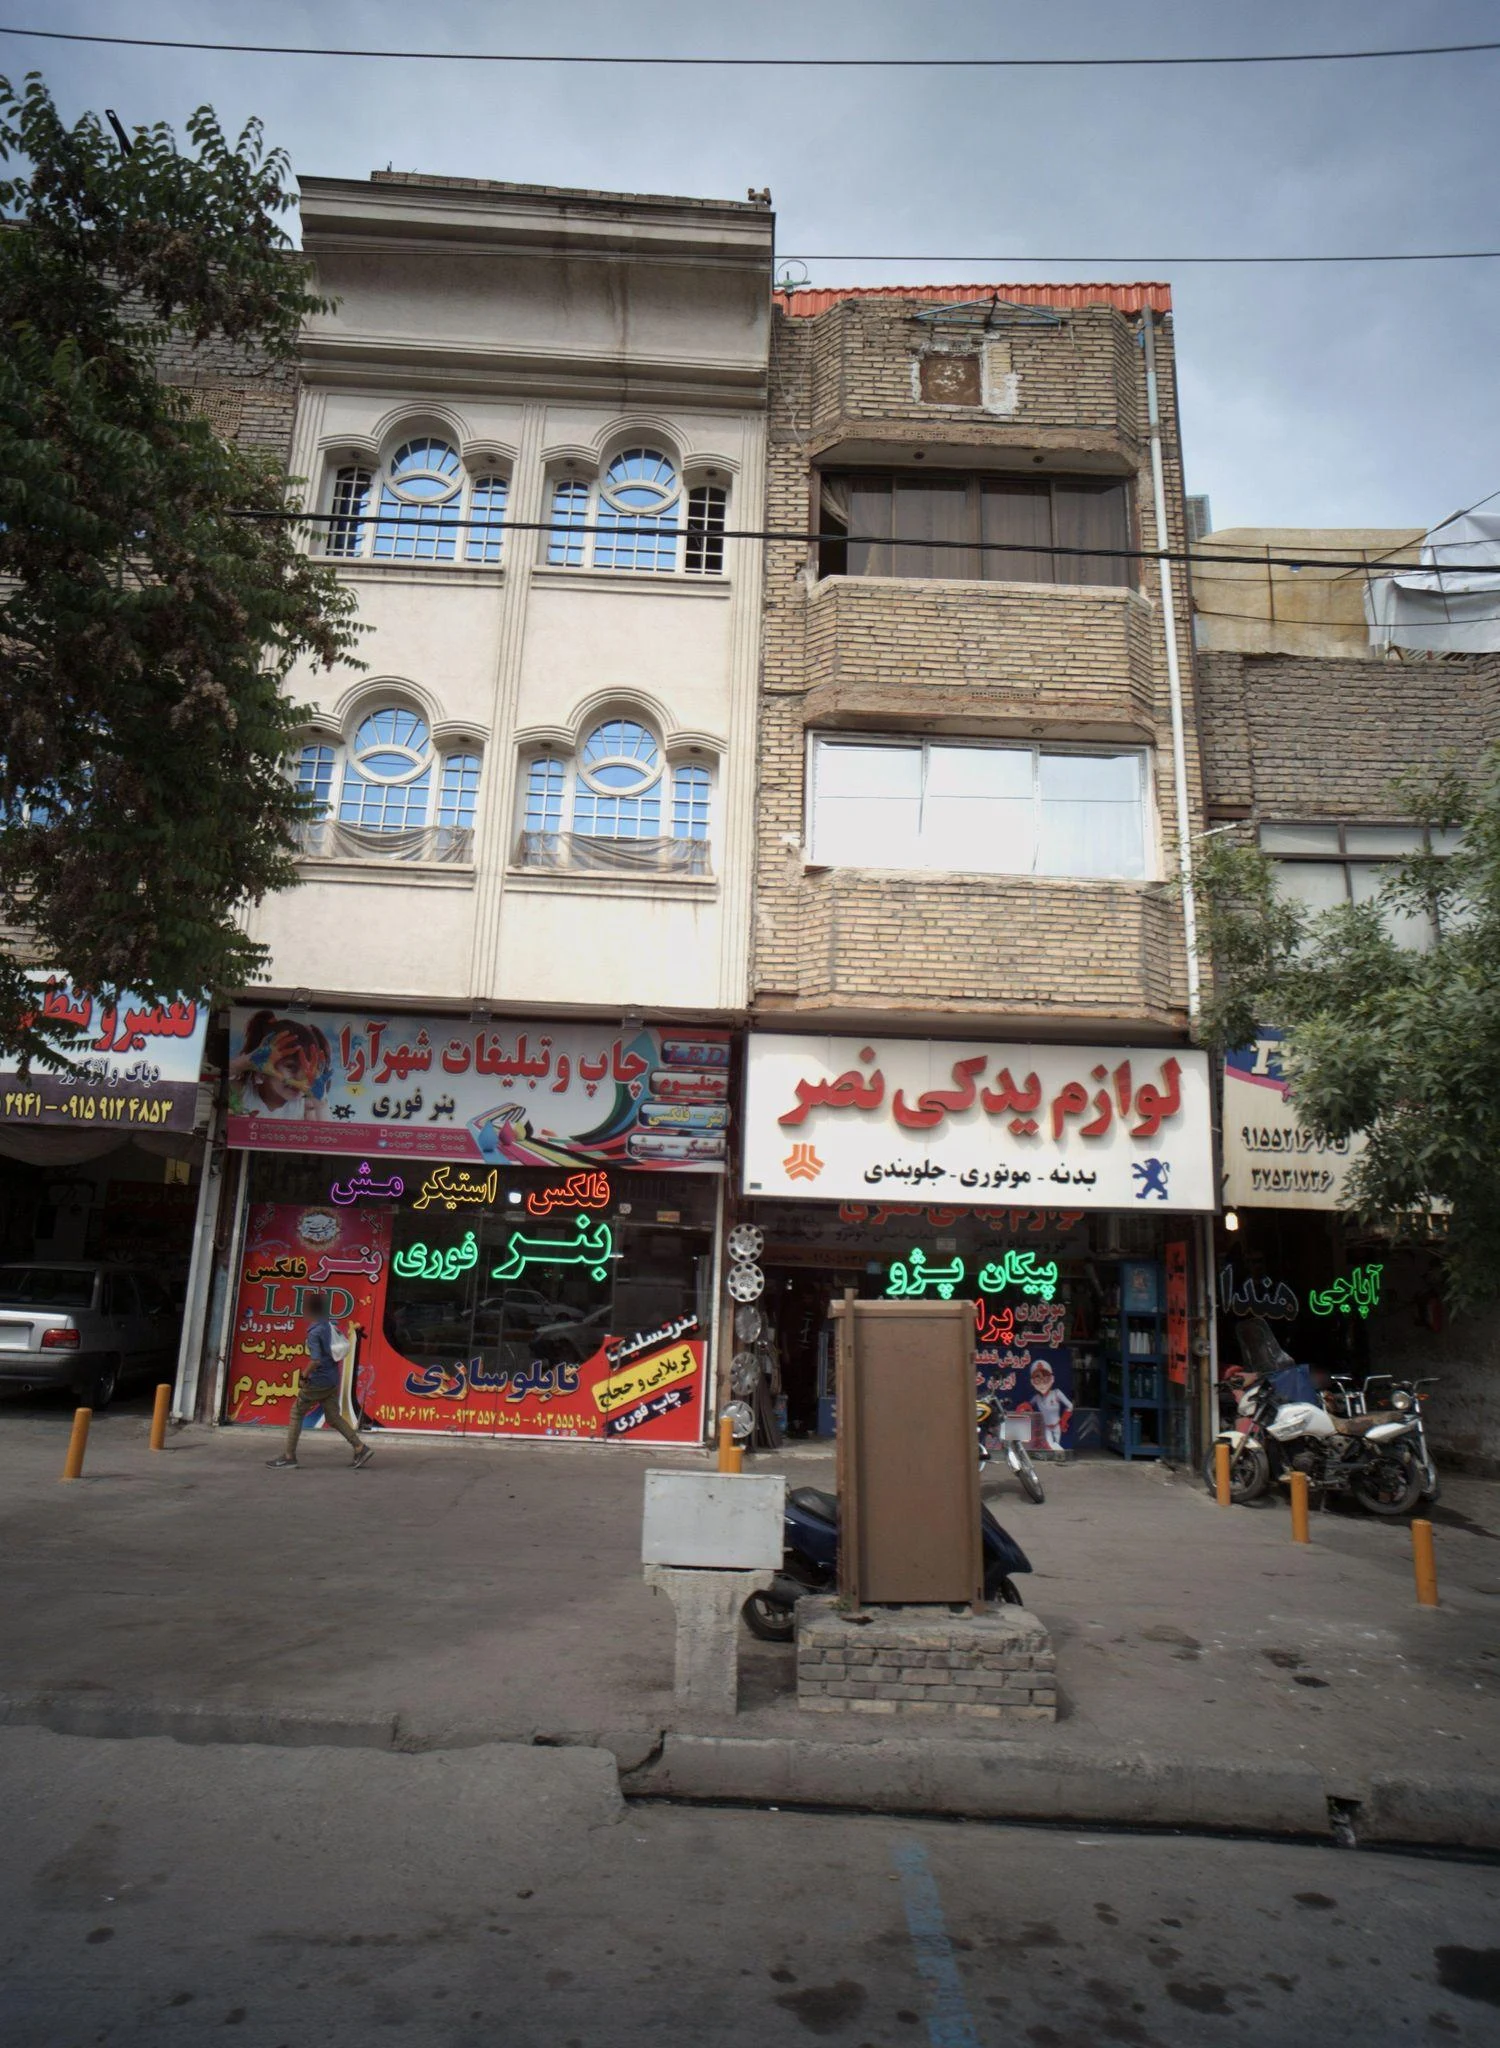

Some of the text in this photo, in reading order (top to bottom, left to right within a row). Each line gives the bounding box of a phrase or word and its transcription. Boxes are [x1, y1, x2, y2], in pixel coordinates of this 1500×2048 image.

[340, 1021, 649, 1098] چاپ و تبلیغات شهرآرا
[3, 1092, 42, 1117] ۲۹۴۱
[61, 1095, 96, 1120] ۰۹۱۵
[99, 1096, 126, 1121] ۹۱۲
[129, 1097, 173, 1124] ۴۸۵۳
[372, 1086, 456, 1121] بنر فوری
[778, 1046, 1182, 1140] لوازم یدکی نصر
[331, 1162, 610, 1215] فلکس استیکر مش
[864, 1158, 946, 1187] جلوبندی
[960, 1160, 1031, 1189] موتوری
[1049, 1161, 1097, 1186] بدنه
[245, 1246, 383, 1283] بنر فلکس
[393, 1213, 613, 1281] بنر فوری
[886, 1247, 1058, 1301] پیکان پژو
[1309, 1264, 1384, 1319] آپاچی
[240, 1337, 311, 1361] امپوزیت
[233, 1369, 300, 1406] لنیوم
[614, 1391, 681, 1431] چاپ فوری
